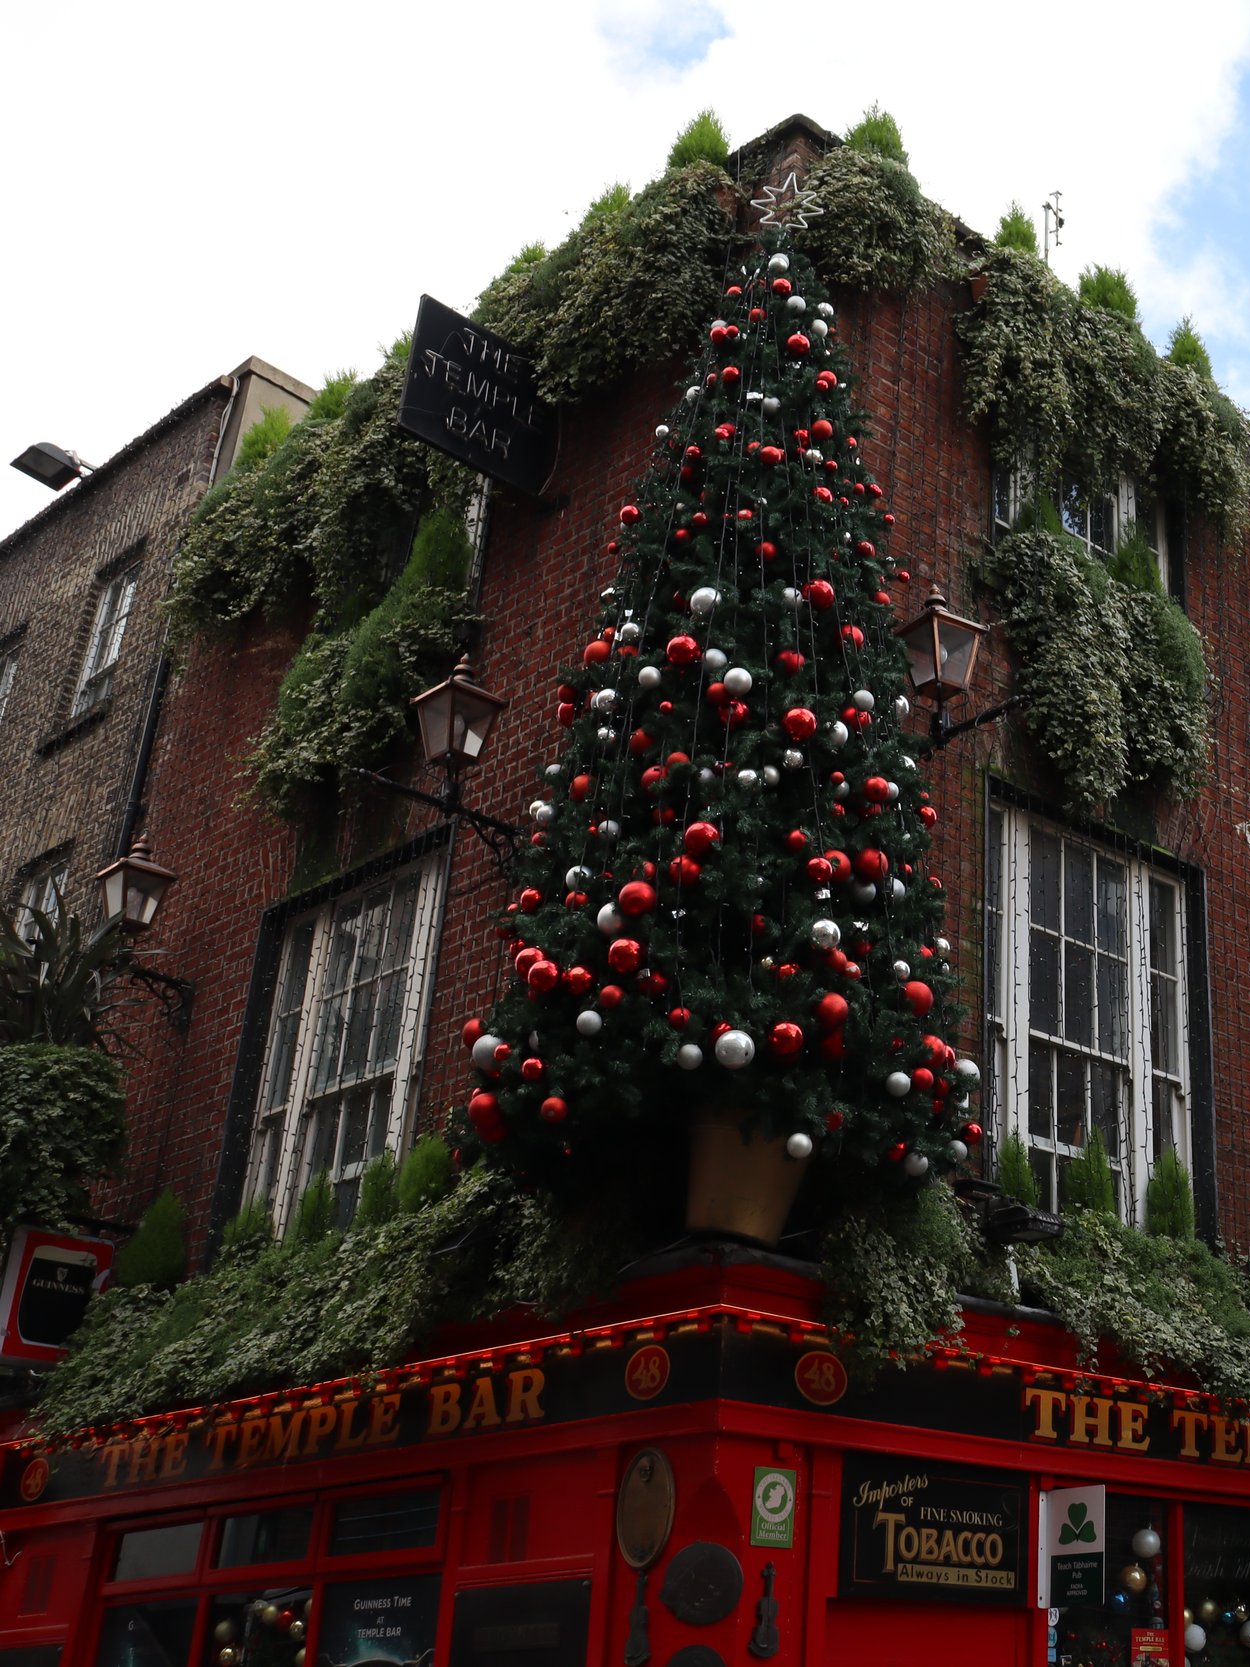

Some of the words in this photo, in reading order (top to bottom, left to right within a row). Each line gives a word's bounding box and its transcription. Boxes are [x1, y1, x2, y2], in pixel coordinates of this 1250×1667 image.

[463, 327, 523, 383] THE
[447, 406, 511, 459] BAR
[33, 1279, 85, 1295] GUINNESS
[630, 1356, 662, 1390] 48
[803, 1359, 836, 1392] 48
[101, 1433, 189, 1488] THE
[206, 1394, 401, 1471] TEMPLE
[427, 1367, 546, 1437] BAR
[1025, 1387, 1151, 1452] THE
[25, 1467, 45, 1494] 48
[853, 1473, 929, 1510] Importers
[900, 1496, 914, 1508] OF
[920, 1506, 947, 1522] FINE
[949, 1510, 1002, 1527] SMOKING
[759, 1529, 787, 1539] Member
[761, 1521, 786, 1531] Official
[872, 1512, 1004, 1573] TOBACCO
[900, 1565, 949, 1583] Always
[957, 1570, 969, 1583] in
[975, 1569, 1013, 1586] Stock
[357, 1627, 385, 1639] TEMPLE
[386, 1626, 402, 1638] BAR
